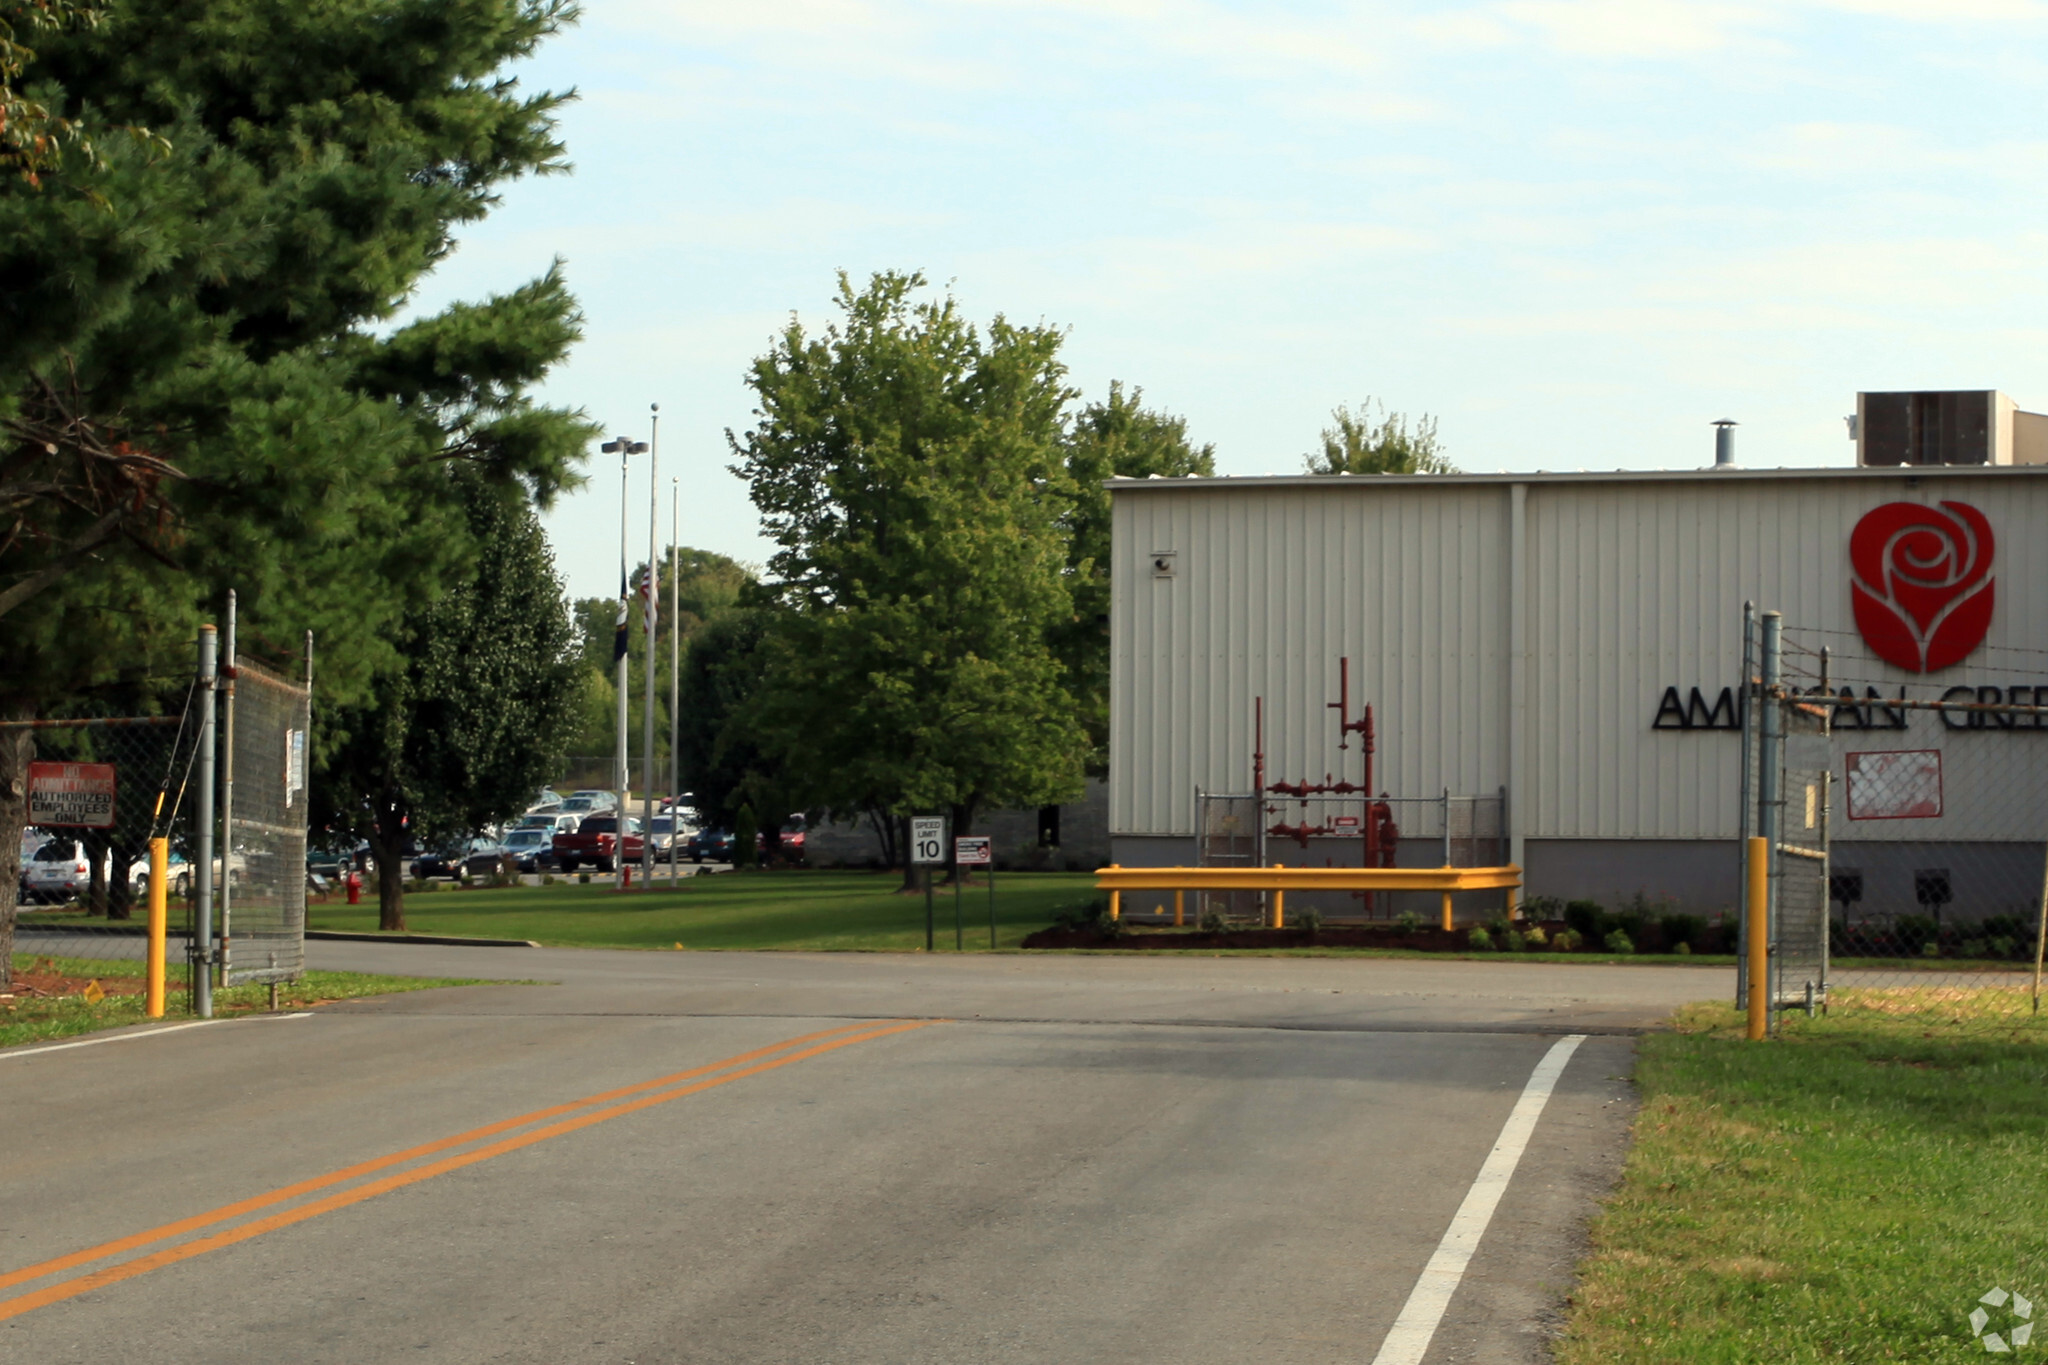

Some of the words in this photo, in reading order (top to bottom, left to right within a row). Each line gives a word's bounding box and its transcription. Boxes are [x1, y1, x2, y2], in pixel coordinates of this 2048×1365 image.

[1652, 686, 1908, 730] AMAN
[63, 765, 80, 778] NO
[32, 777, 113, 791] ADMITTANCE
[31, 792, 112, 803] AUTHORIZED
[32, 801, 110, 814] EMPLOYEES
[55, 812, 86, 823] ONLY
[915, 821, 940, 829] SPEED
[918, 830, 937, 838] LIMIT
[916, 840, 940, 858] 10
